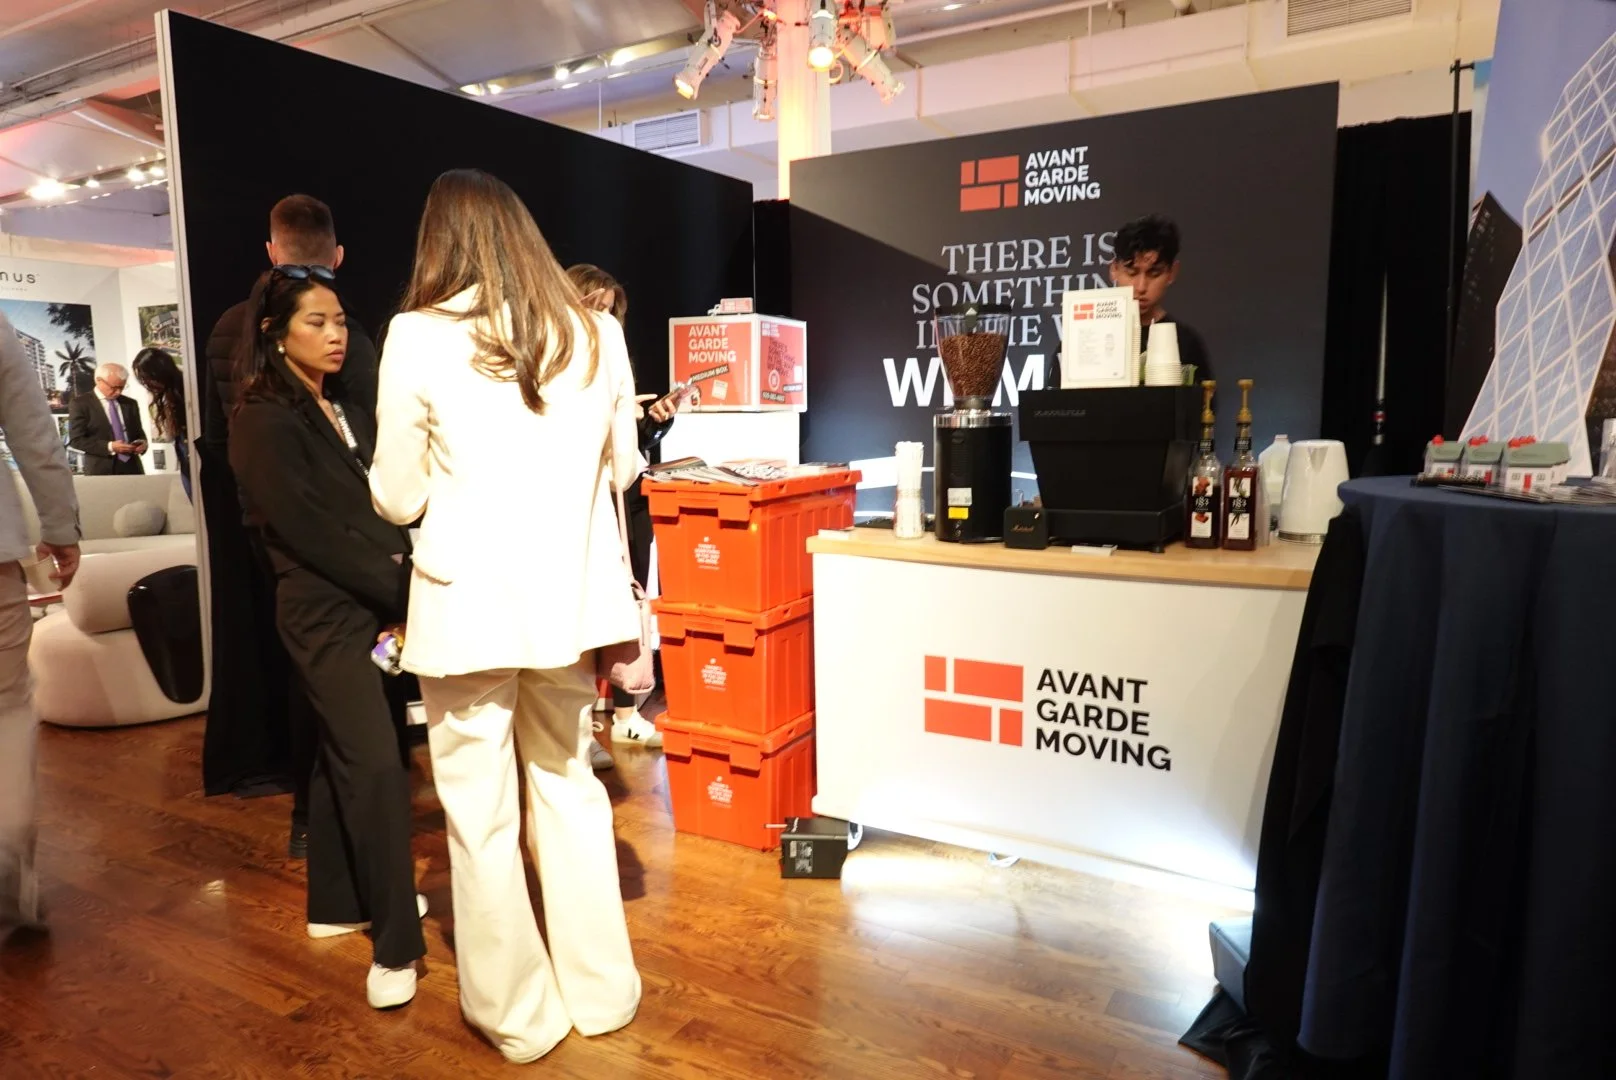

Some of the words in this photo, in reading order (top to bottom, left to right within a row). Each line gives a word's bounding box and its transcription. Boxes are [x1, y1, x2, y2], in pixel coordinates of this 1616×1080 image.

[1025, 146, 1088, 170] AVANT
[1025, 165, 1089, 188] GARDE
[1024, 182, 1101, 206] MOVING
[941, 235, 1071, 275] THERE
[1082, 231, 1118, 267] IS
[912, 272, 1118, 314] SOMETHIN
[688, 324, 728, 337] AVANT
[688, 338, 728, 350] GARDE
[688, 351, 736, 363] MOVING
[1036, 668, 1148, 704] AVANT
[1036, 698, 1150, 736] GARDE
[1036, 727, 1172, 771] MOVING
